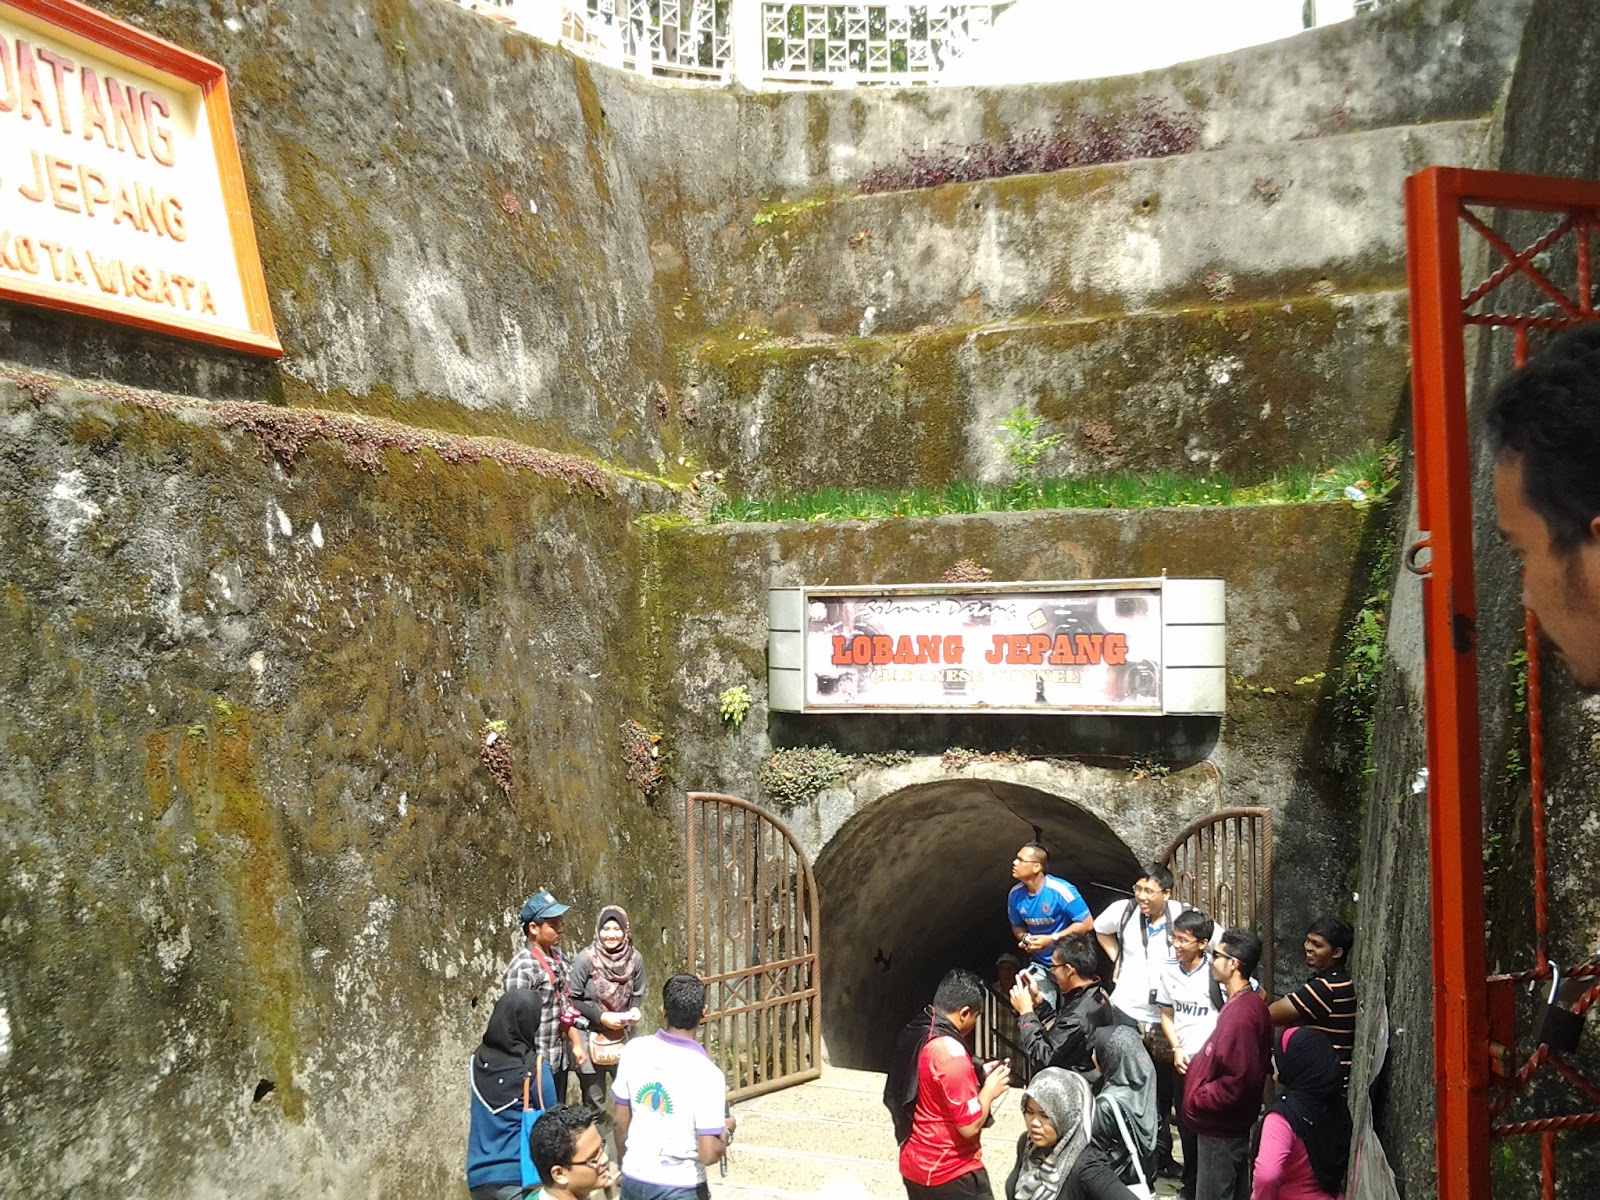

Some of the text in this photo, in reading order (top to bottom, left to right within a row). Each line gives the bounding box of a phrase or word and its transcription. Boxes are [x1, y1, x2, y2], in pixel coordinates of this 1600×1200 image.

[18, 148, 188, 243] JEPANG
[831, 632, 1128, 665] LOBANG JEPANG
